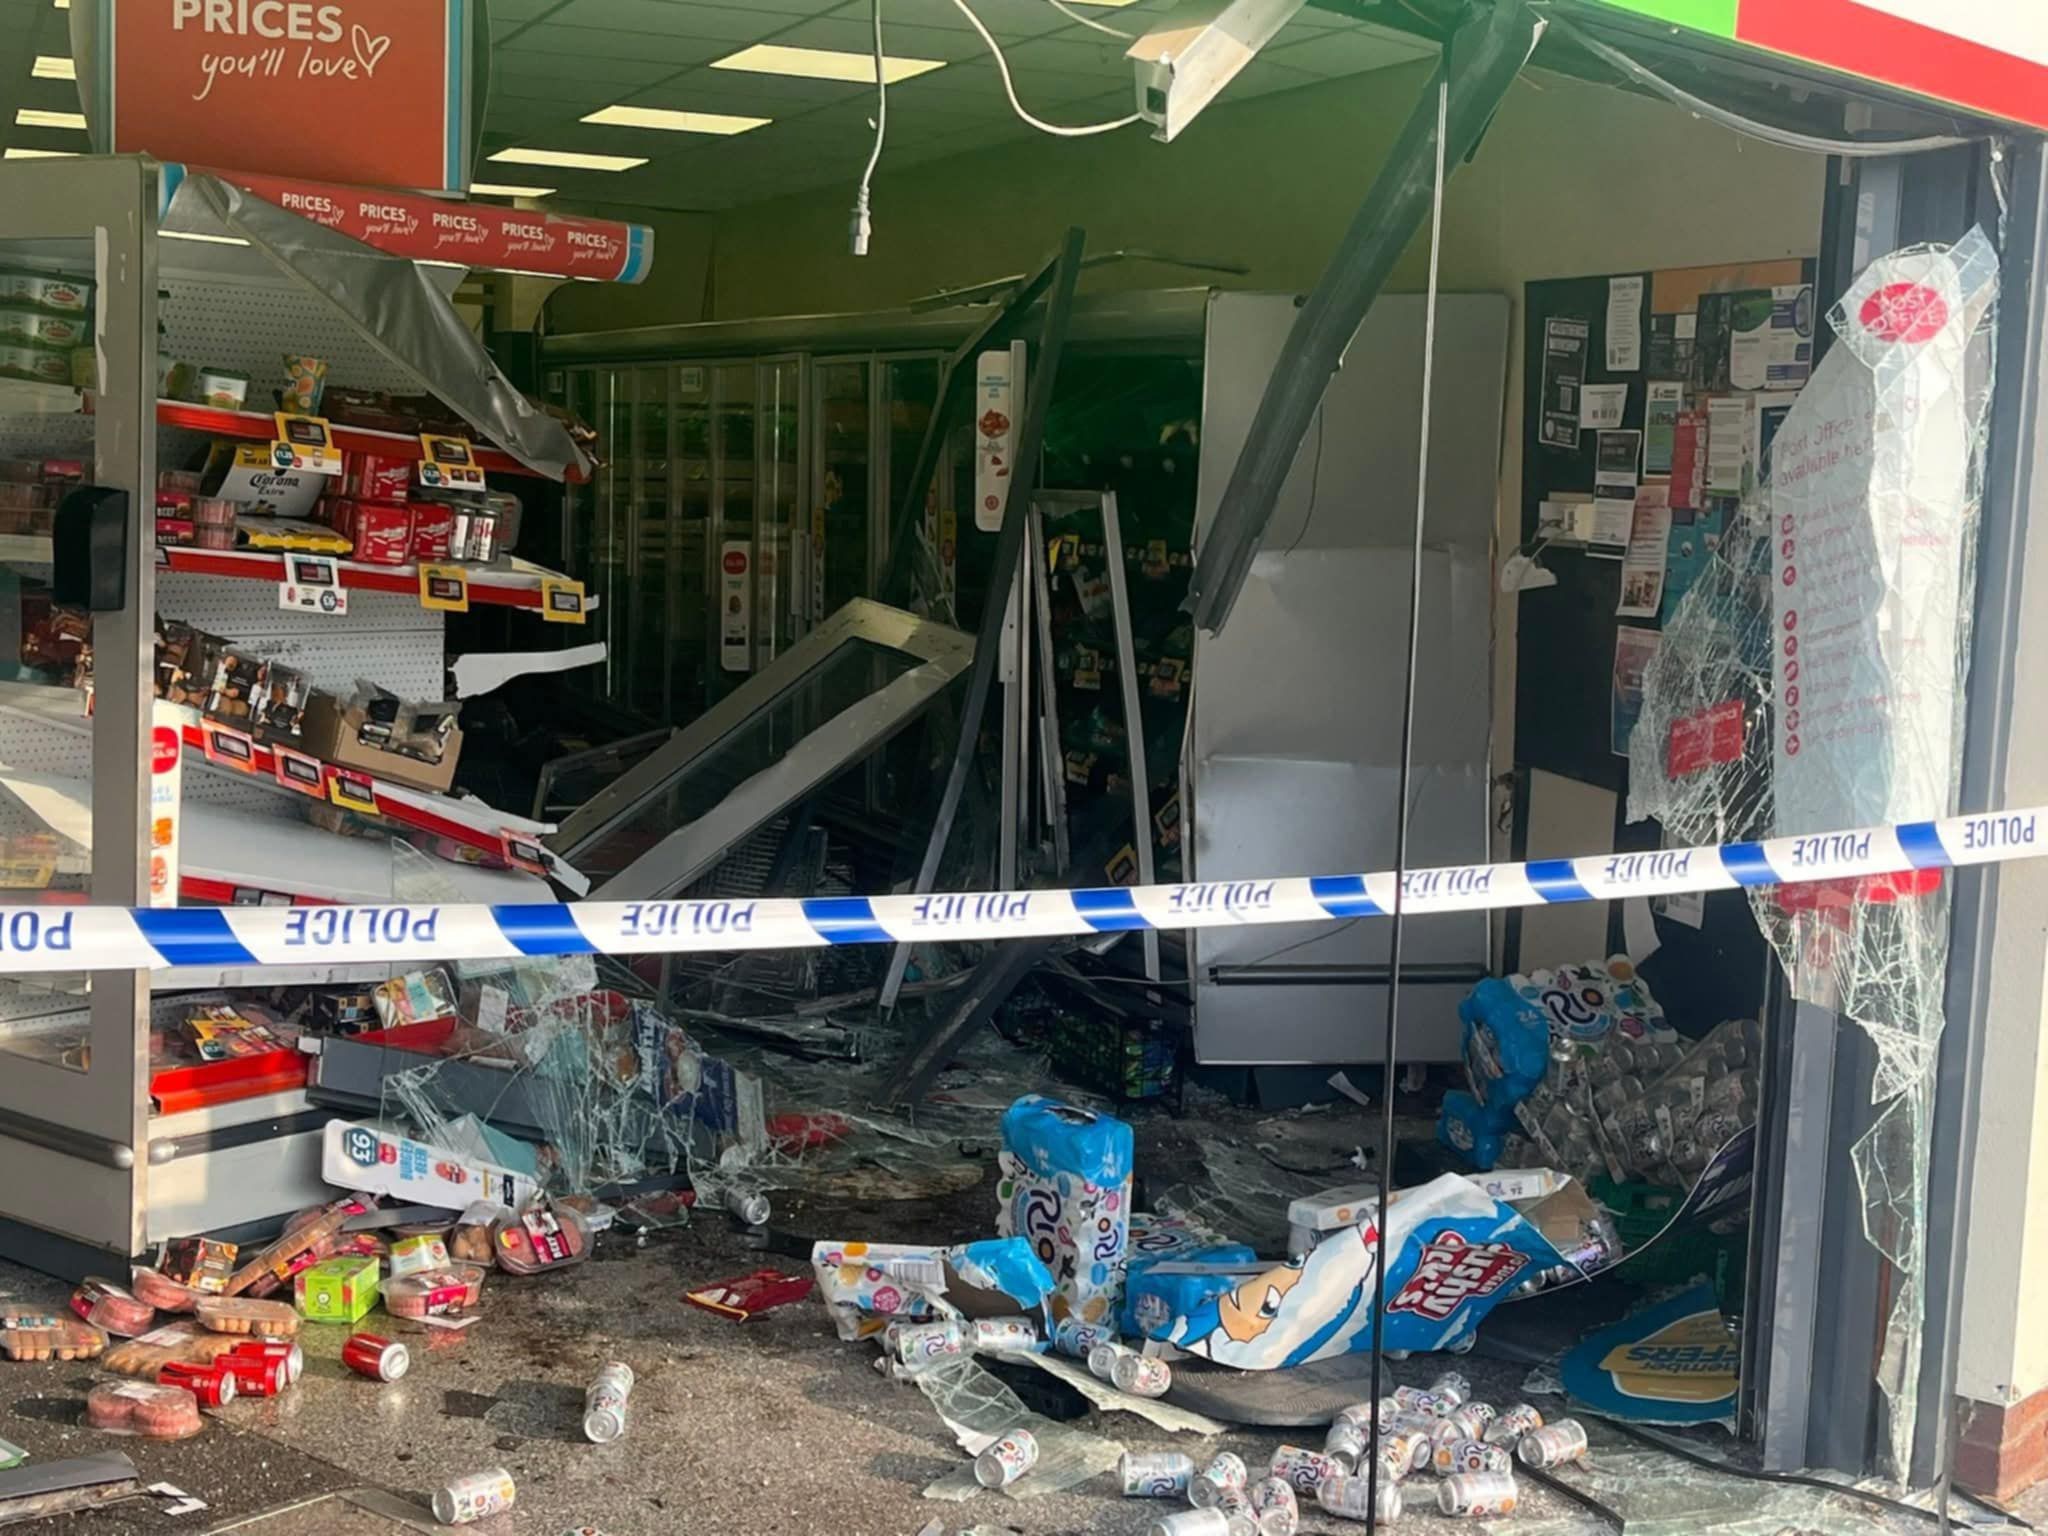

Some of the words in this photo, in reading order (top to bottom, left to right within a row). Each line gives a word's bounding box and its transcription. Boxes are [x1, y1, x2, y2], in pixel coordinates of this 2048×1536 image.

[173, 0, 344, 43] PRICES
[192, 47, 286, 101] you'll
[298, 46, 359, 79] love
[281, 192, 332, 213] PRICES
[359, 202, 407, 223] PRICES
[432, 212, 478, 232] PRICES
[501, 221, 544, 241] PRICES
[567, 230, 609, 250] PRICES
[249, 472, 301, 488] Corona
[258, 487, 285, 496] Extra
[1964, 814, 2036, 849] POLICE
[1791, 832, 1872, 867] POLICE
[1603, 851, 1691, 883] POLICE
[911, 894, 1030, 926] POLICE
[1168, 882, 1276, 913] POLICE
[284, 908, 440, 946] POLICE
[620, 903, 755, 936] POLICE
